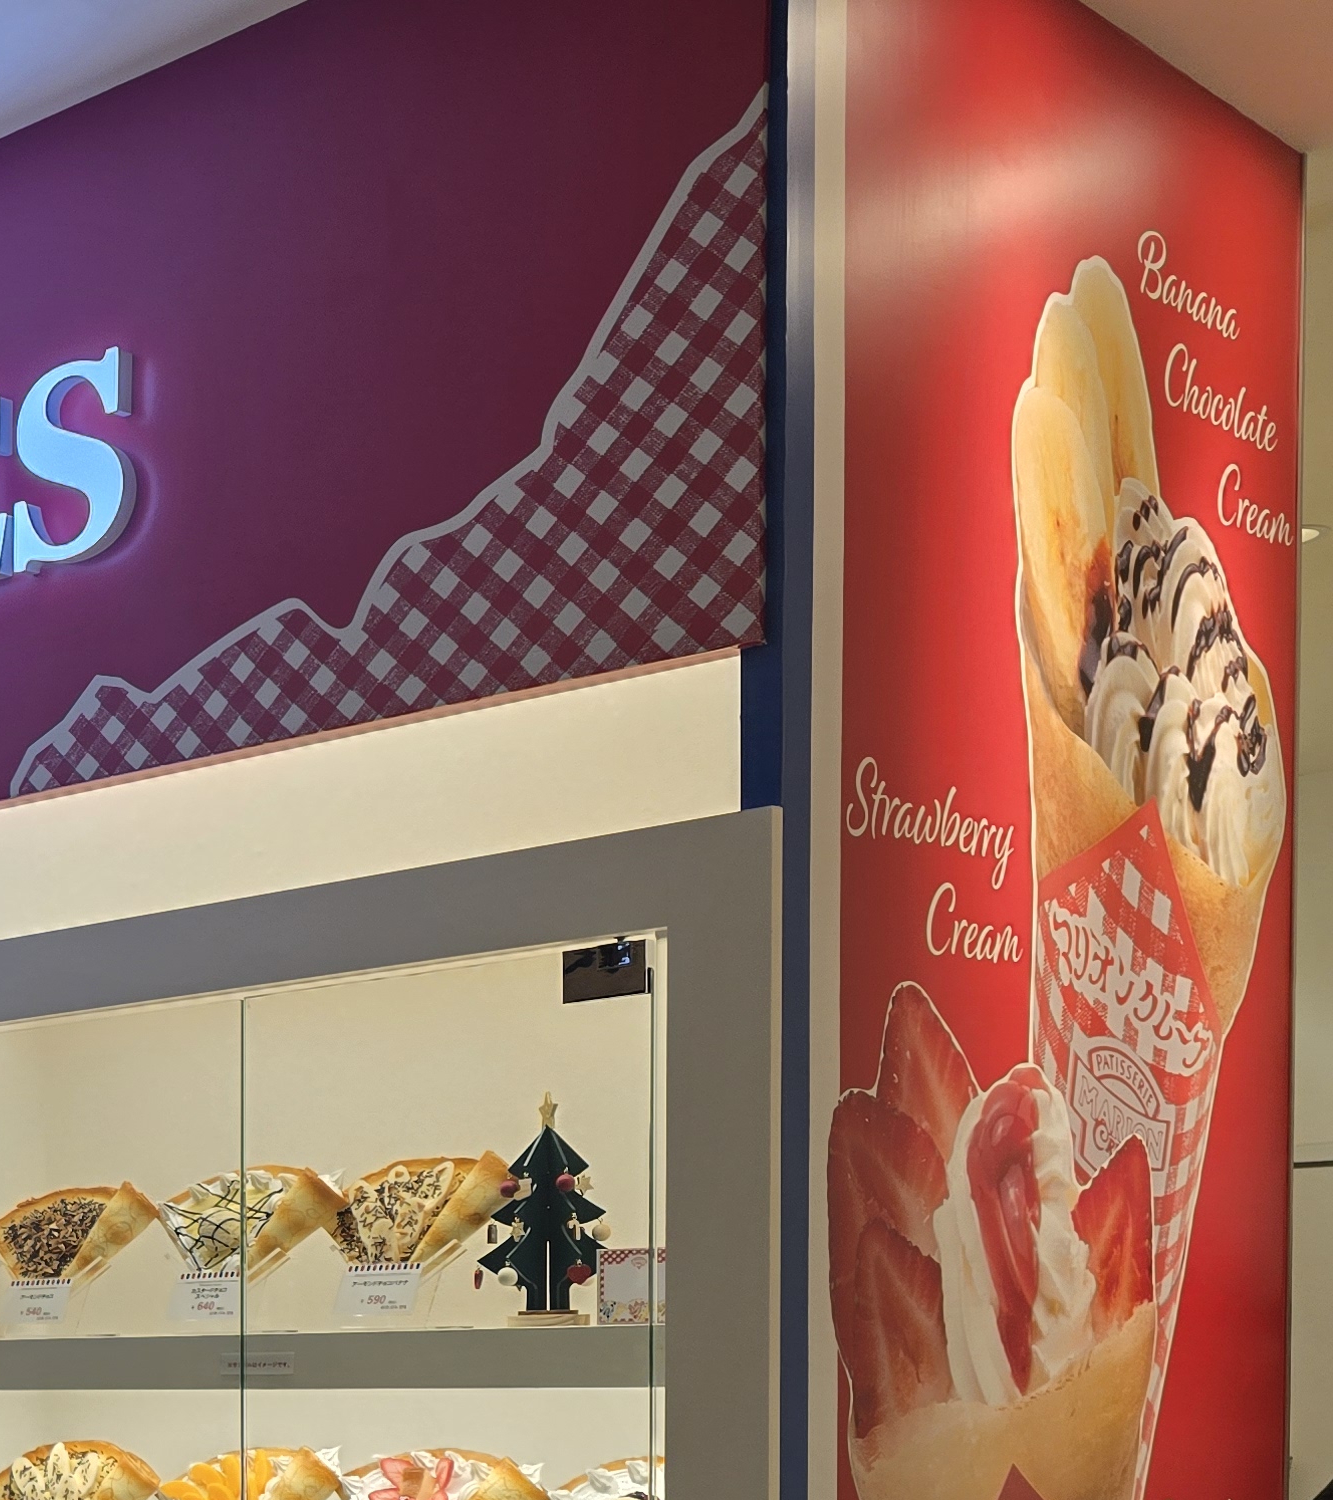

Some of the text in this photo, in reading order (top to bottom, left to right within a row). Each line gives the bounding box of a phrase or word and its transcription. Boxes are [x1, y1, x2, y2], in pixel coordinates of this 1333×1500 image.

[1136, 230, 1241, 342] Banana
[1163, 342, 1279, 454] Chocolate
[1216, 463, 1294, 548] Cream
[845, 755, 1015, 889] Strawberry
[926, 882, 1023, 964] Cream
[1096, 1054, 1154, 1107] PATISSERIE
[26, 1307, 42, 1316] 540
[197, 1301, 215, 1310] 640
[367, 1295, 387, 1304] 590
